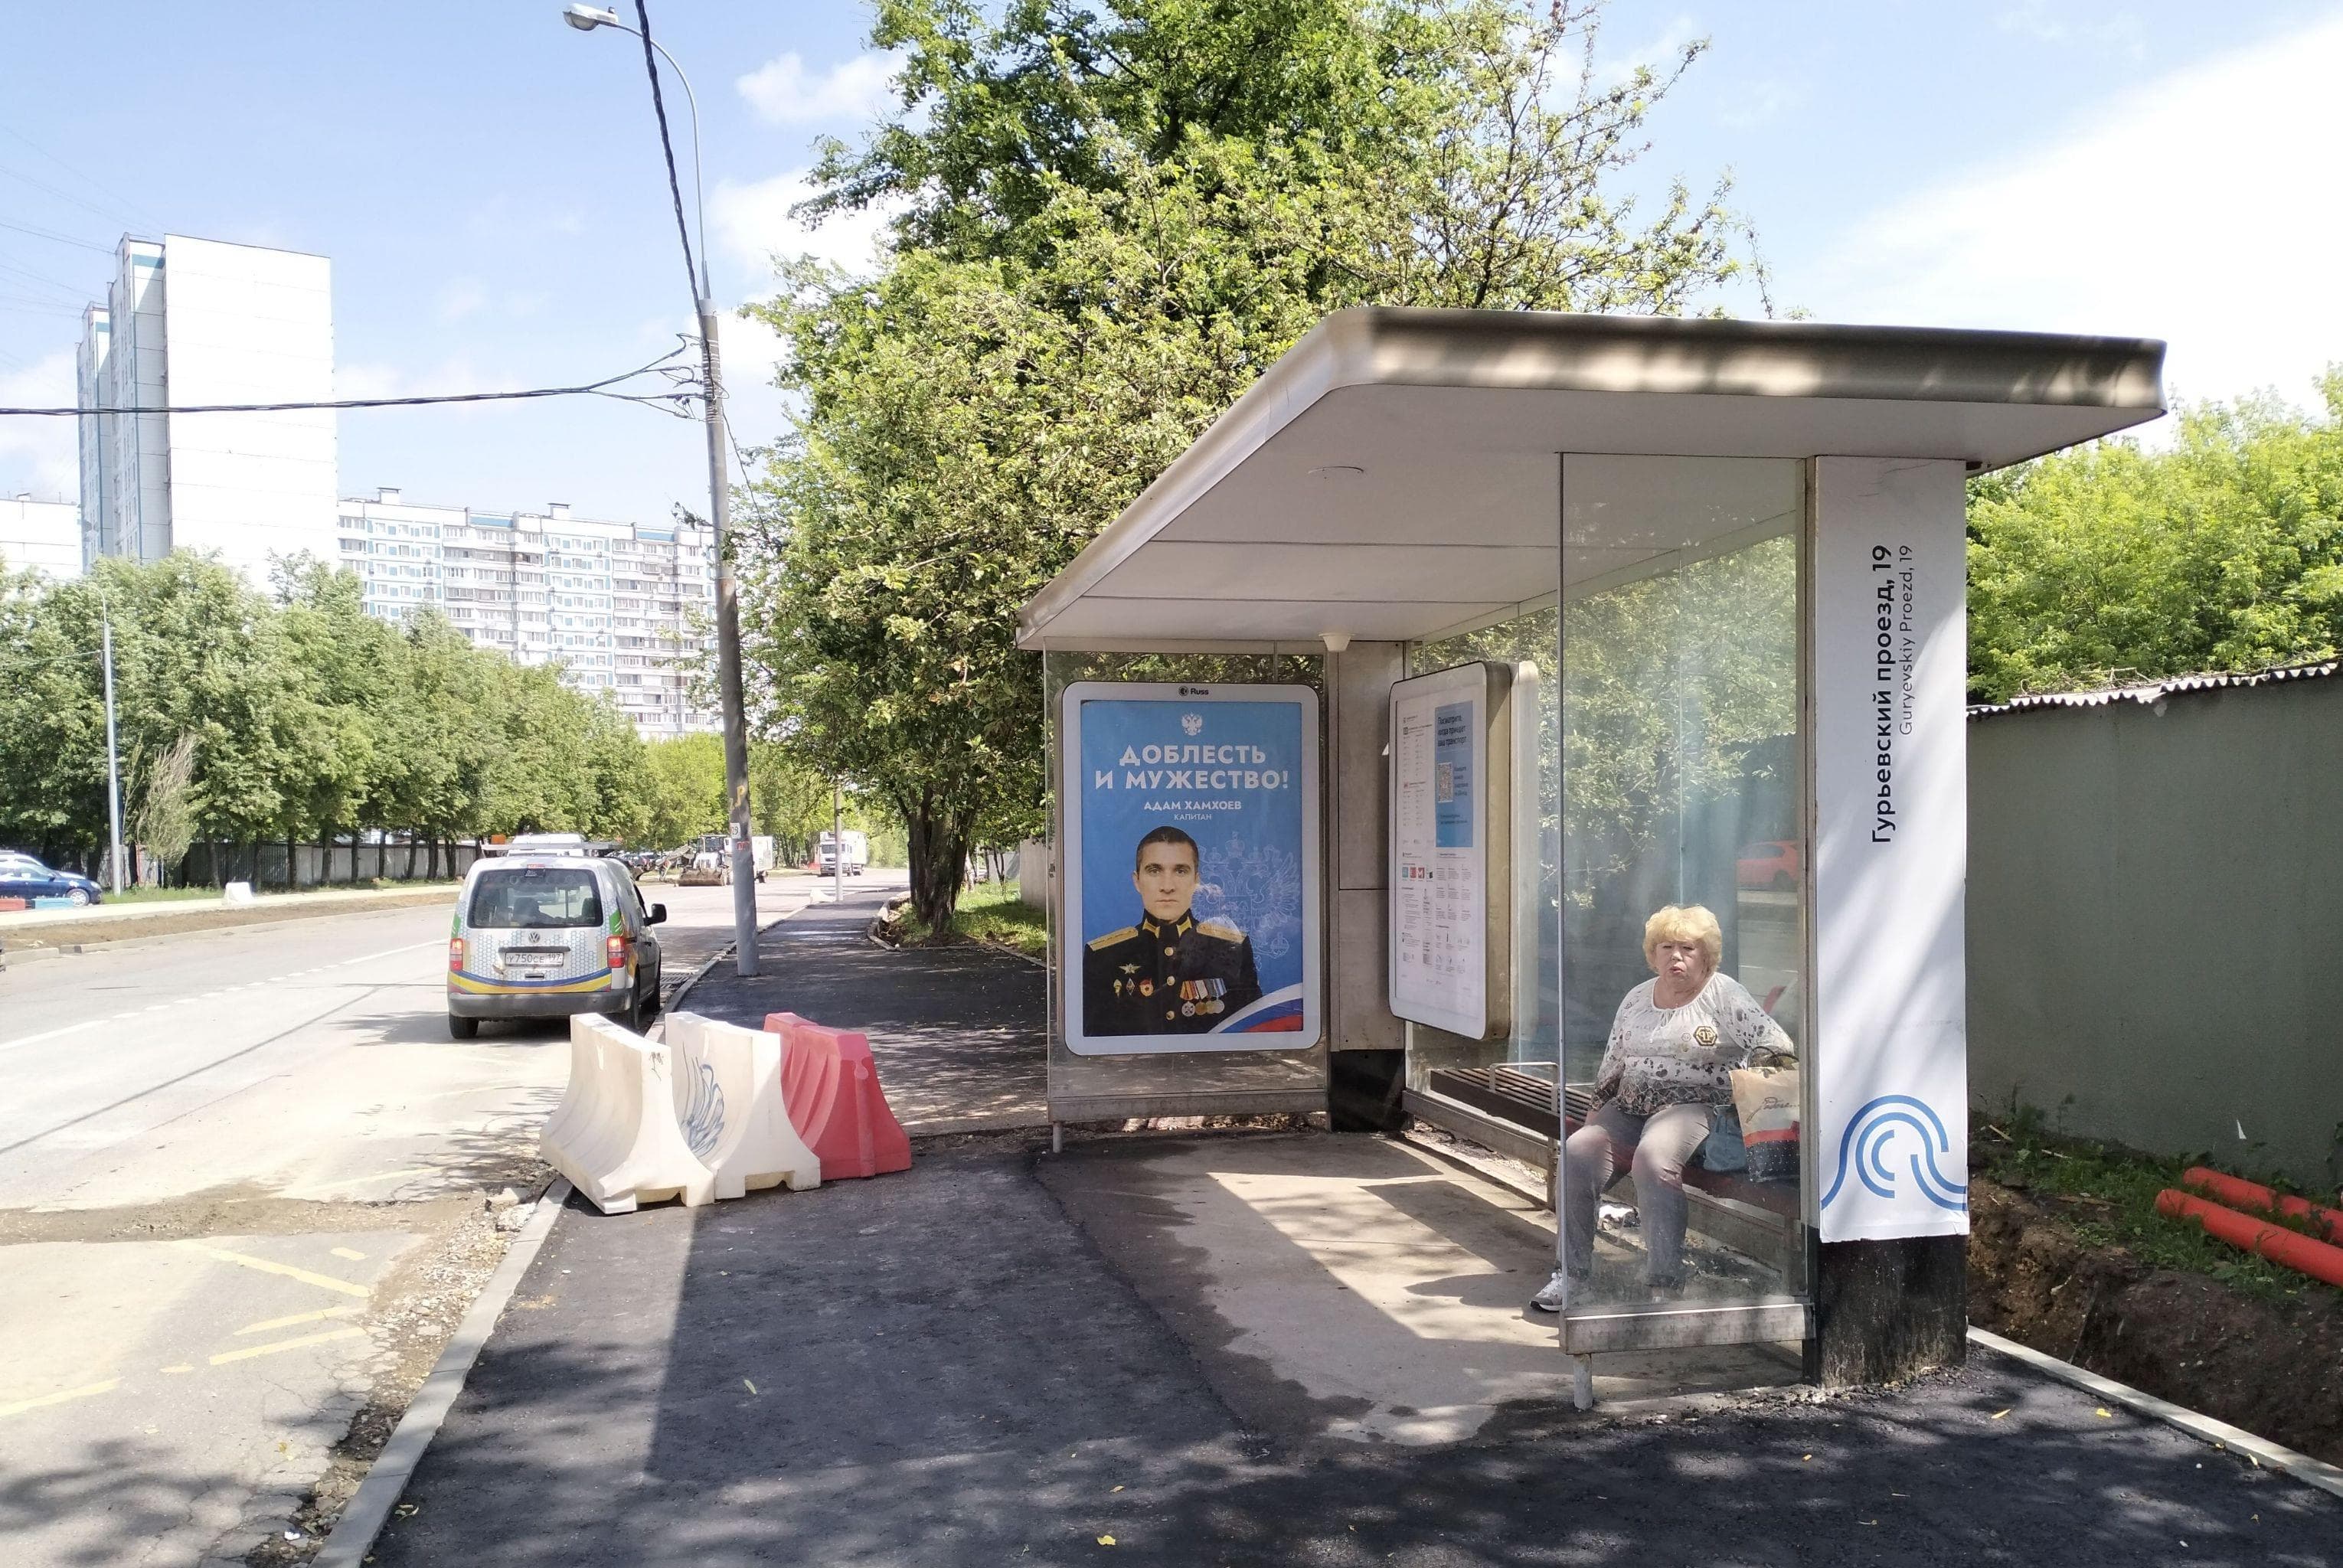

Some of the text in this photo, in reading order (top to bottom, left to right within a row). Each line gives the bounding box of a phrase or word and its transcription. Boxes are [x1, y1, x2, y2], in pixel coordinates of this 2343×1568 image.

[1898, 545, 1916, 735] Guryevskiy Proezd, 19
[1872, 545, 1896, 842] Гурьевский проезд, 19
[1119, 744, 1266, 766] ДОБЛЕСТЬ
[1095, 770, 1289, 790] И МУЖЕСТВО!
[1144, 801, 1242, 811] АДАМ ХАМХОЕВ
